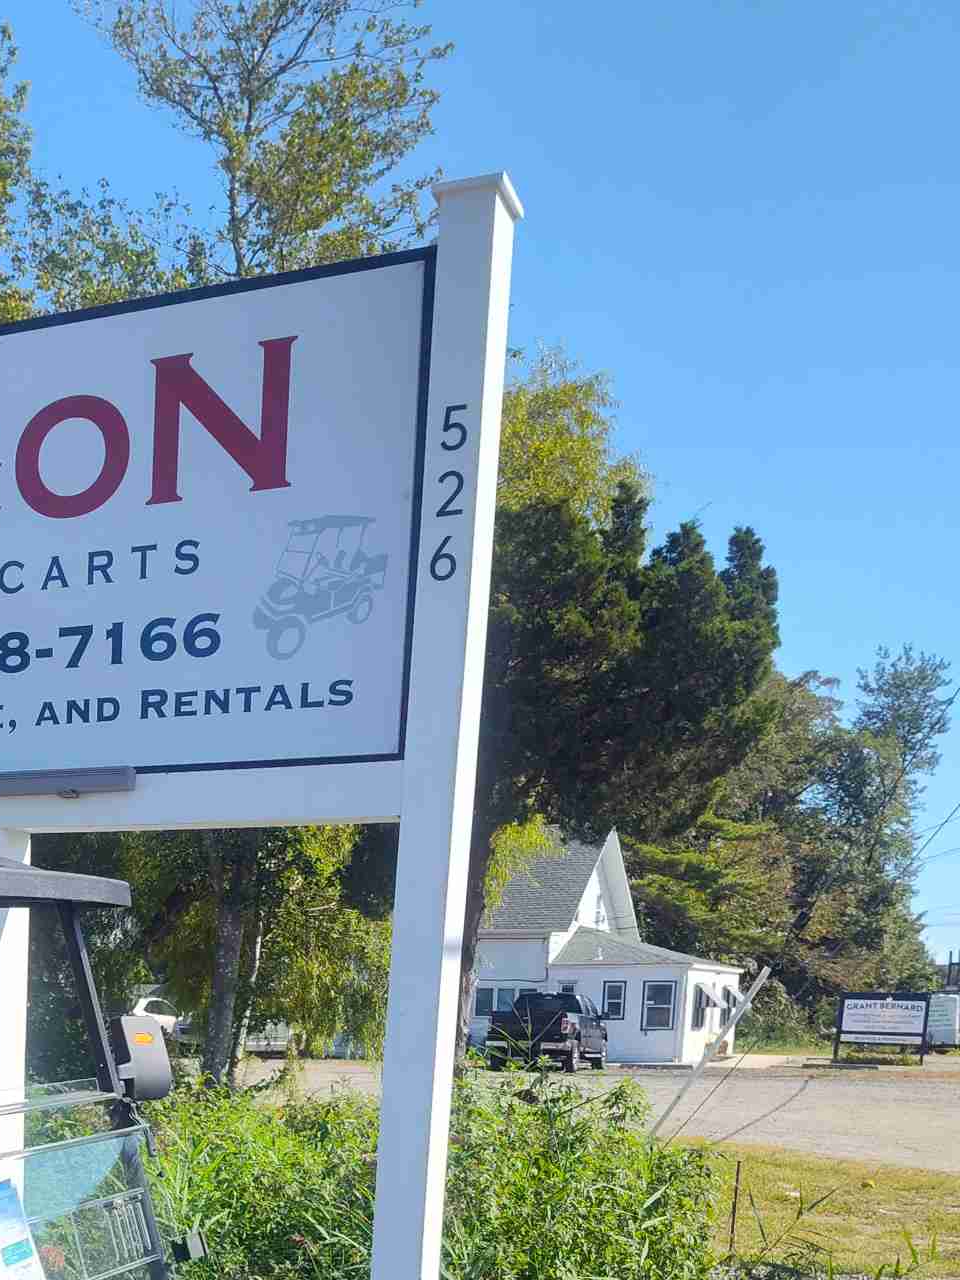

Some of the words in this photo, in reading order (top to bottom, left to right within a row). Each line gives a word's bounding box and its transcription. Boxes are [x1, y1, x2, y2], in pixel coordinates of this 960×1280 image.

[34, 697, 121, 727] AND
[140, 679, 355, 720] RENTALS
[846, 1000, 878, 1010] GRANT
